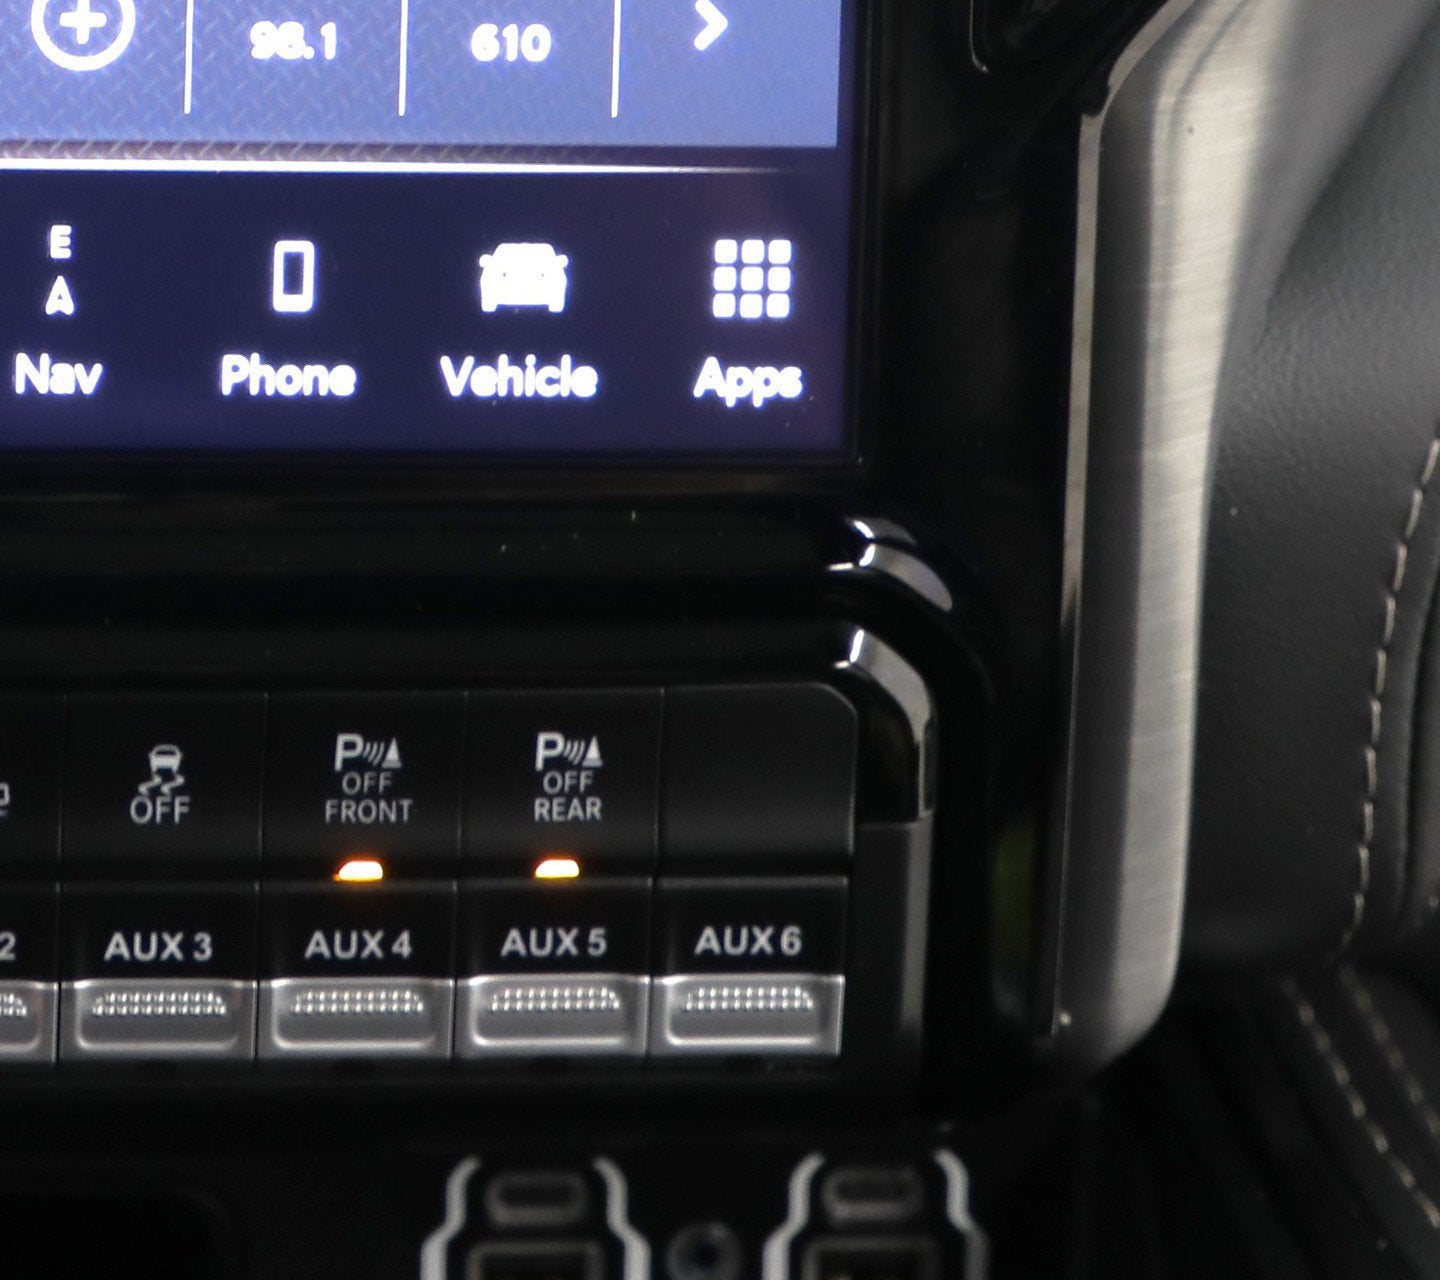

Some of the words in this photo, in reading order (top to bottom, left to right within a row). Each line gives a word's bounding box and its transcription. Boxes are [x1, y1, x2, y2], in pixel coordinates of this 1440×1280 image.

[470, 23, 553, 63] 610
[13, 353, 103, 396] Nav
[220, 354, 358, 397] Phone
[439, 354, 599, 399] Vehicle
[693, 356, 805, 408] Apps
[342, 771, 394, 796] OFF
[543, 770, 594, 795] OFF
[129, 795, 191, 825] OFF
[324, 799, 413, 825] FRONT
[534, 797, 602, 823] REAR
[103, 931, 186, 963] AUX
[192, 931, 215, 962] 3
[304, 929, 385, 961] AUX
[391, 929, 413, 959] 4
[500, 926, 580, 958] AUX
[587, 926, 609, 958] 5
[693, 925, 774, 957] AUX
[780, 925, 803, 957] 6
